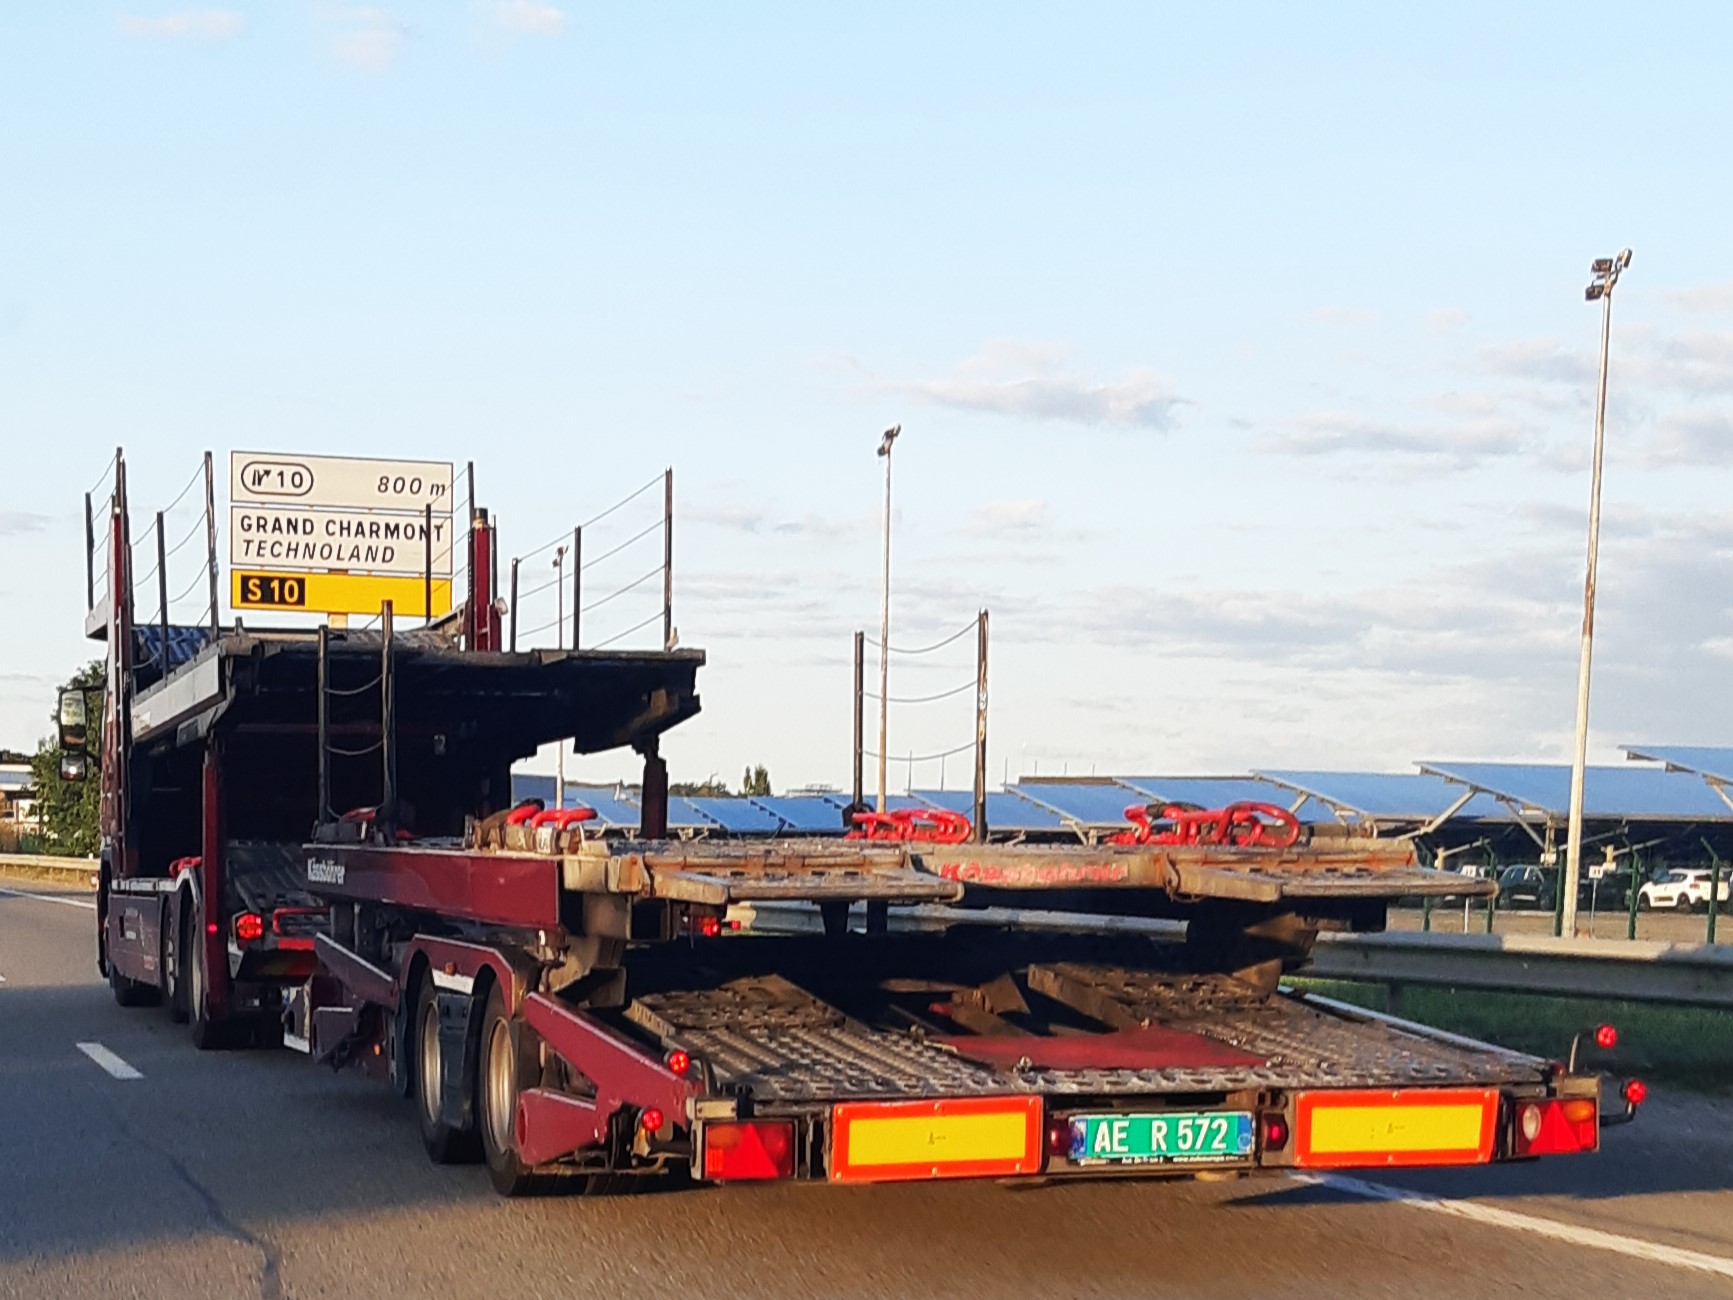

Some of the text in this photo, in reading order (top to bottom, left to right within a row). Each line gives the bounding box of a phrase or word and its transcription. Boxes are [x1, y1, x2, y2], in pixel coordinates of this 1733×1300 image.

[276, 470, 304, 489] 10
[377, 475, 446, 497] 800 m
[240, 514, 444, 542] GRAND CHARMONT
[242, 538, 395, 564] TECHNOLAND
[247, 578, 299, 603] S 10
[1094, 1119, 1130, 1153] AE
